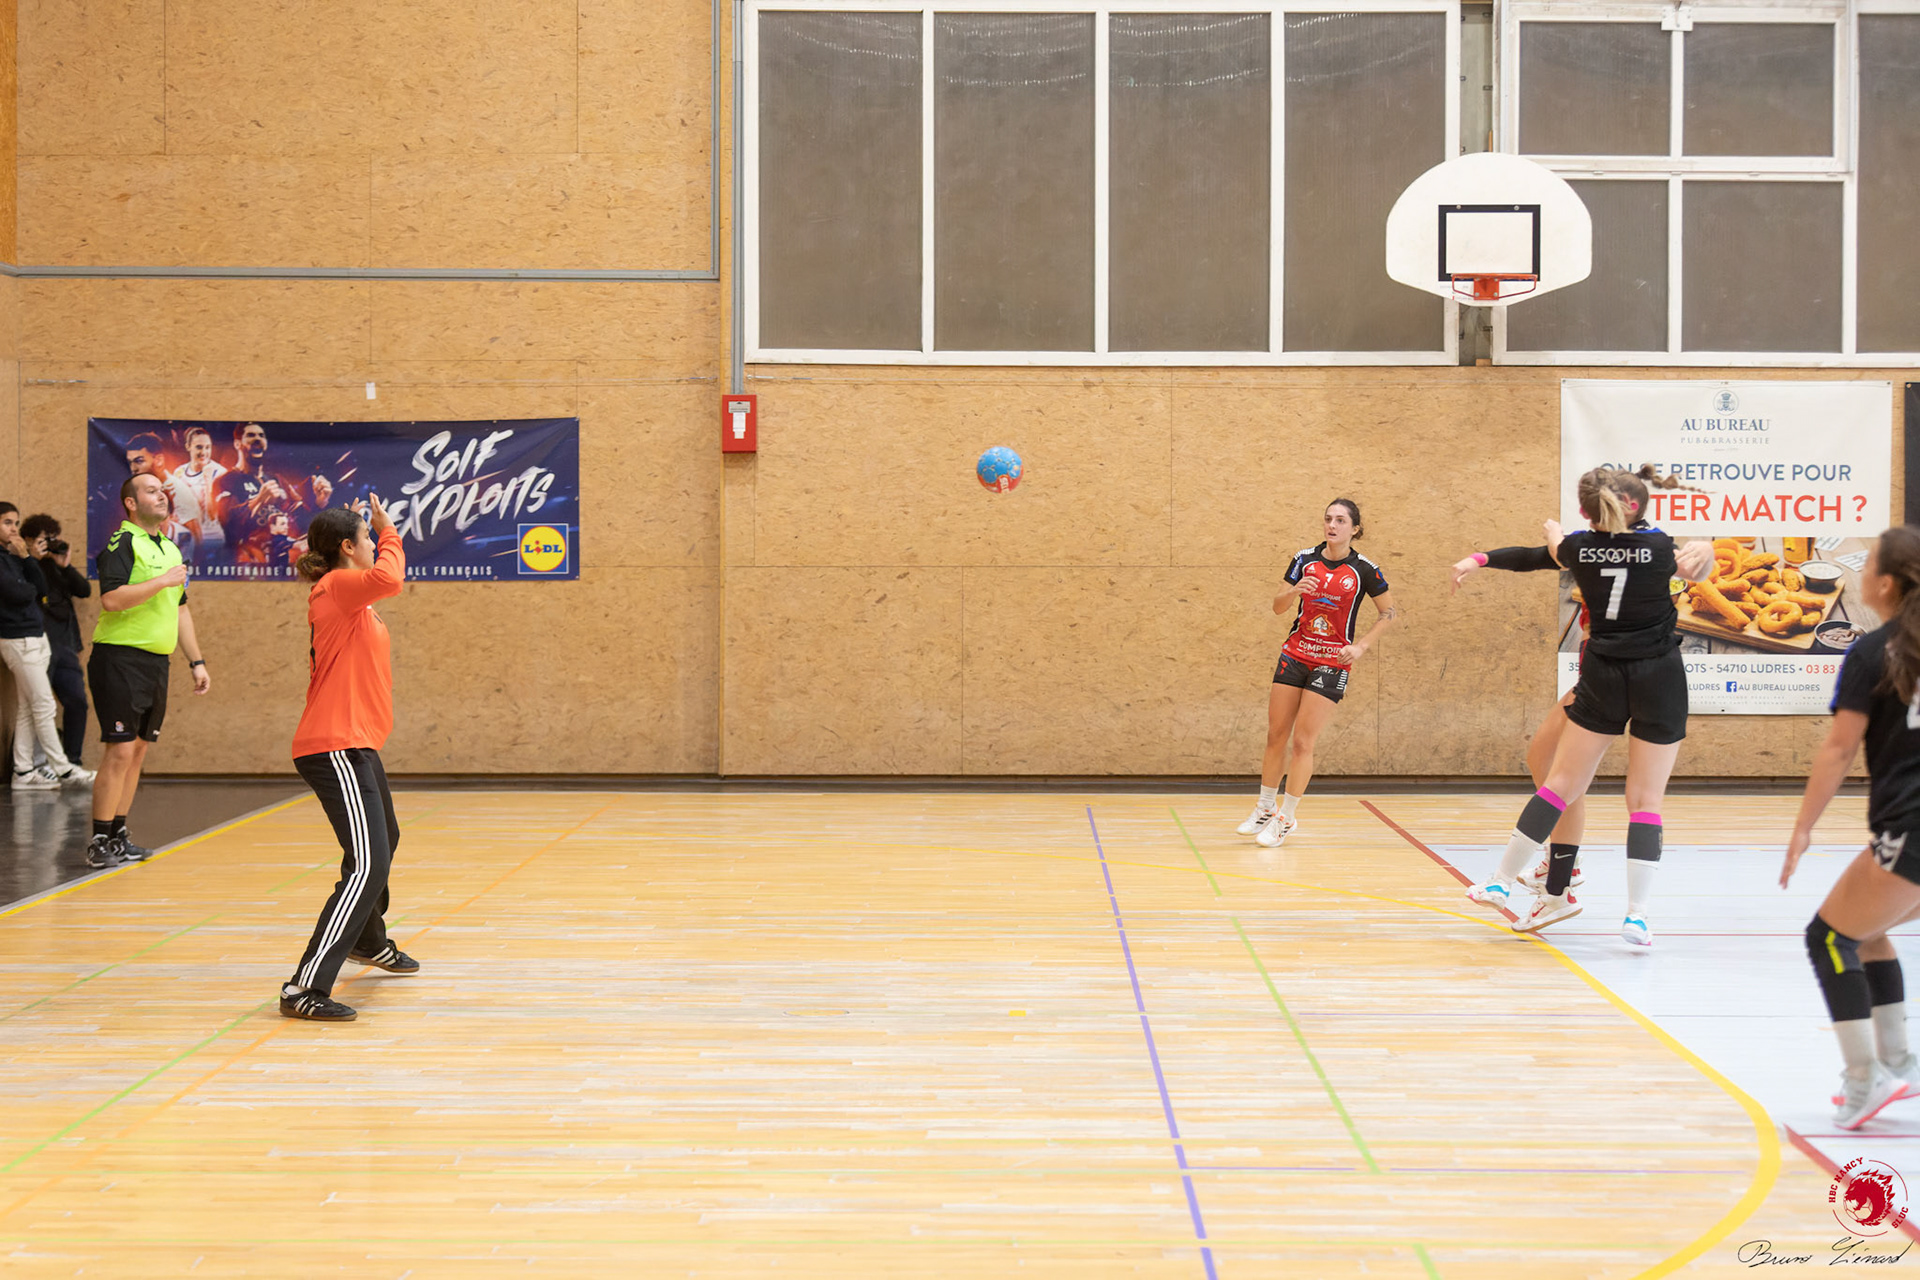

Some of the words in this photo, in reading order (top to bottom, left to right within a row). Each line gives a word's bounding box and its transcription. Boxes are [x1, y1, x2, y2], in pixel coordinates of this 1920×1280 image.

[1680, 419, 1702, 431] AU
[1706, 419, 1770, 431] BUREAU
[1671, 463, 1785, 481] RETROUVE
[1792, 464, 1851, 481] POUR
[1720, 494, 1841, 522] MATCH
[1852, 495, 1867, 522] ?
[207, 566, 279, 576] PARTENAIRE
[434, 566, 492, 578] FRANÇAIS
[1323, 572, 1334, 589] 7
[1600, 568, 1628, 620] 7
[1716, 664, 1747, 674] 54710
[1750, 664, 1795, 674] LUDRES
[1806, 664, 1820, 674] 03
[1822, 664, 1836, 674] 83
[1788, 684, 1820, 692] LUDRES
